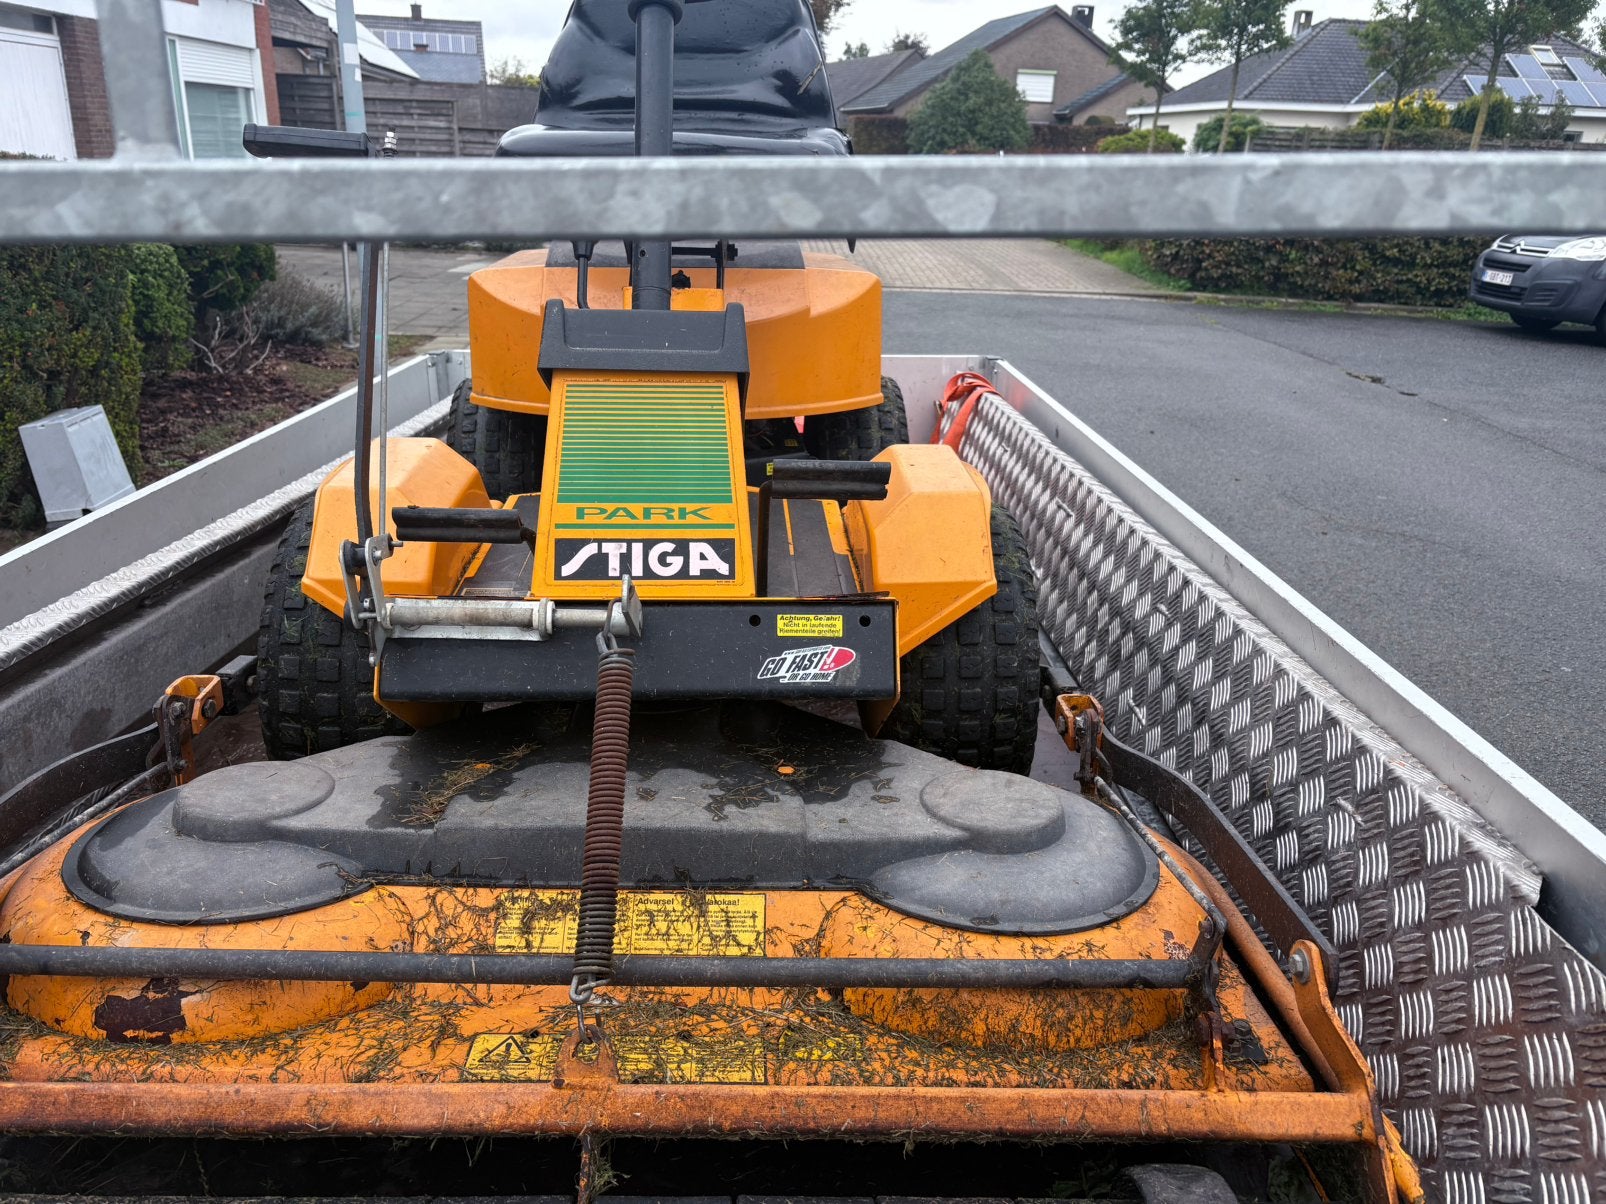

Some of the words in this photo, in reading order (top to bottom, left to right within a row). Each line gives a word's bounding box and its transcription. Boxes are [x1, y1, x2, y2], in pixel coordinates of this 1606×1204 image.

[576, 507, 713, 520] PARK
[561, 542, 729, 577] STIGA
[760, 658, 787, 677] GO
[787, 672, 798, 681] OR
[799, 672, 810, 681] GO
[810, 672, 833, 681] HOME
[637, 897, 674, 905] Advarsel
